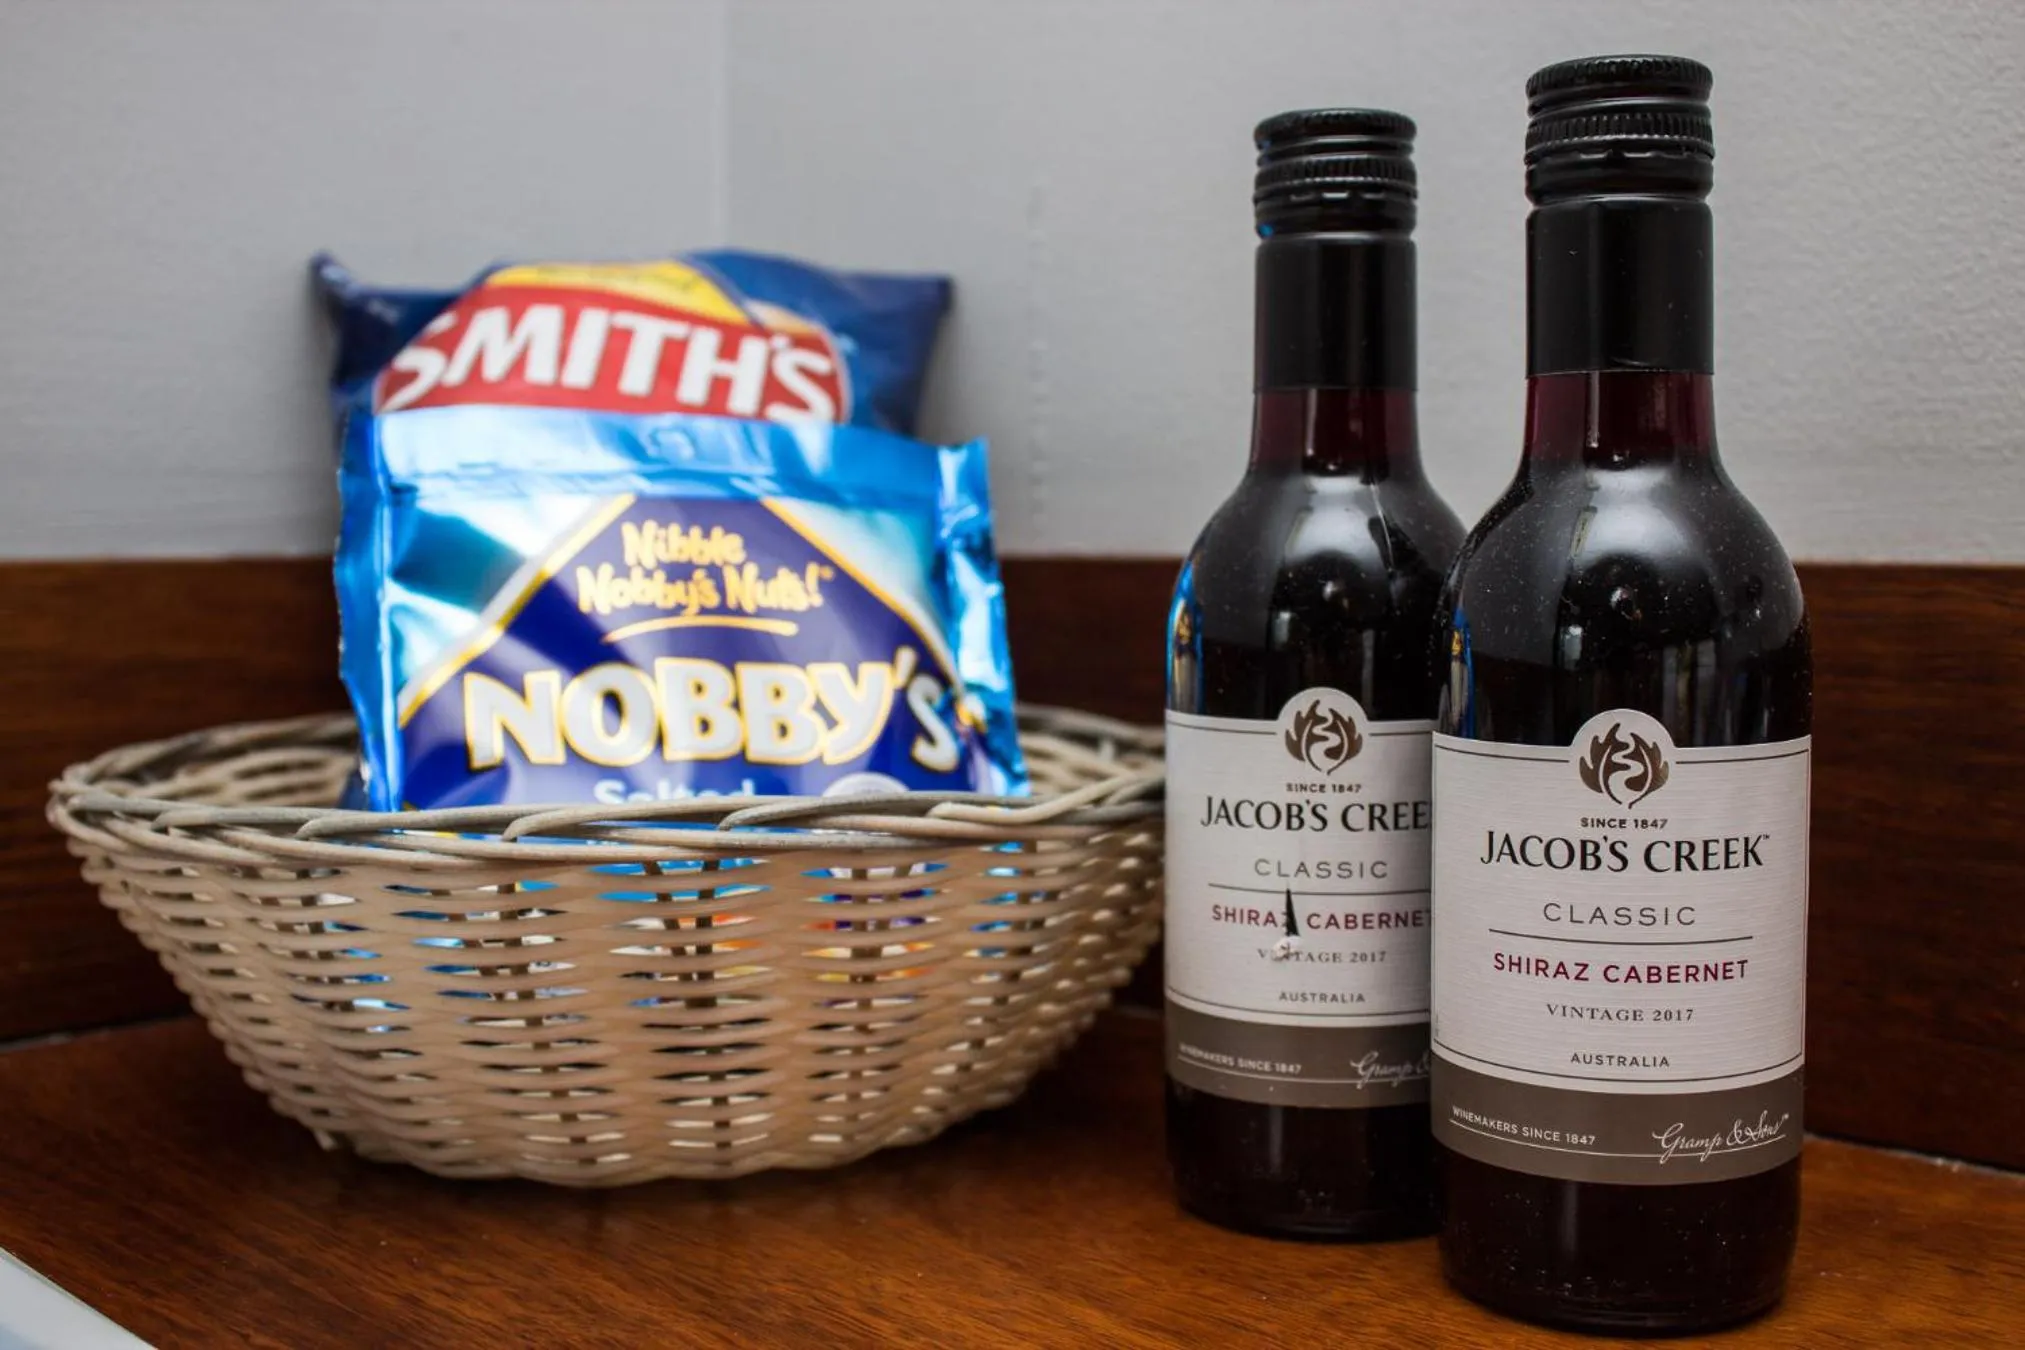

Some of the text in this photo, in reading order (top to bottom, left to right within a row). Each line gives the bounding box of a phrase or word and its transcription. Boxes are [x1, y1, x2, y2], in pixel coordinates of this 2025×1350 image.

[381, 303, 834, 425] SMITH'S
[620, 519, 746, 569] Nibble
[575, 561, 720, 617] Nobby's
[1286, 782, 1363, 793] SINCE 1847
[1200, 796, 1430, 832] JACOB'S CREE
[1580, 817, 1669, 830] SINCE 1847
[1480, 830, 1629, 873] JACOB'S
[1254, 858, 1389, 879] CLASSIC
[1543, 902, 1696, 927] CLASSIC
[1257, 948, 1387, 963] VTAGE 2017
[1493, 952, 1749, 985] SHIRAZ CABERNET
[1278, 991, 1366, 1003] AUSTRALIA
[1545, 1003, 1695, 1022] VINTAGE 2017
[1237, 1058, 1273, 1073] SINCE
[1275, 1062, 1303, 1075] 1847
[1570, 1052, 1671, 1068] AUSTRALIA
[1452, 1105, 1596, 1146] WINEMAKERS SINCE 1847
[1652, 1122, 1724, 1165] Gramp
[1726, 1118, 1752, 1146] &
